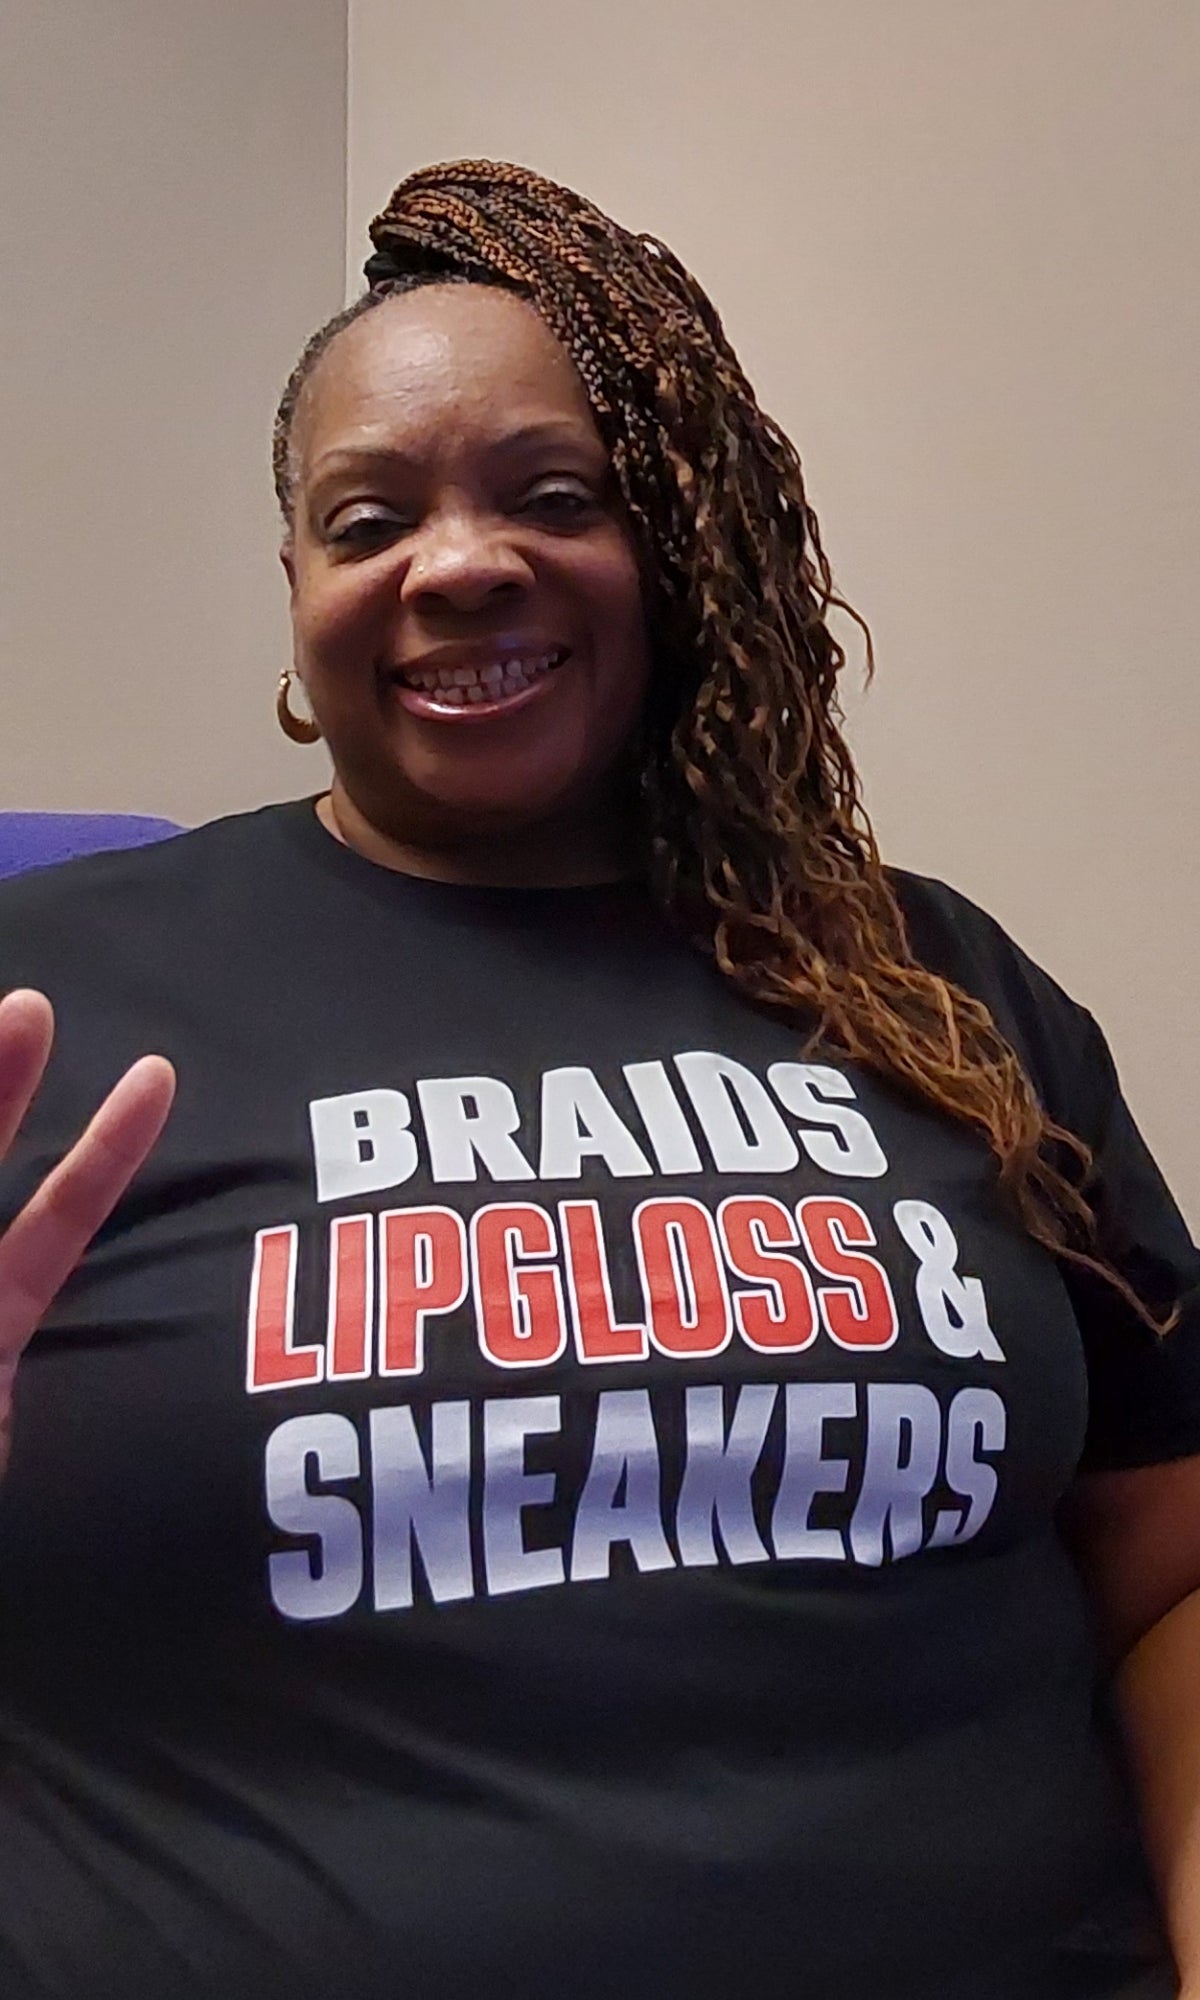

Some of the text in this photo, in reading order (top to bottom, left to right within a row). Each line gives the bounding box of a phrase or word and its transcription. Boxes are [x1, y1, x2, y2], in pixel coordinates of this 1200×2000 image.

[309, 1051, 888, 1203] BRAIDS
[246, 1195, 1006, 1394] LIPGLOSS &
[264, 1382, 1006, 1621] SNEAKERS
